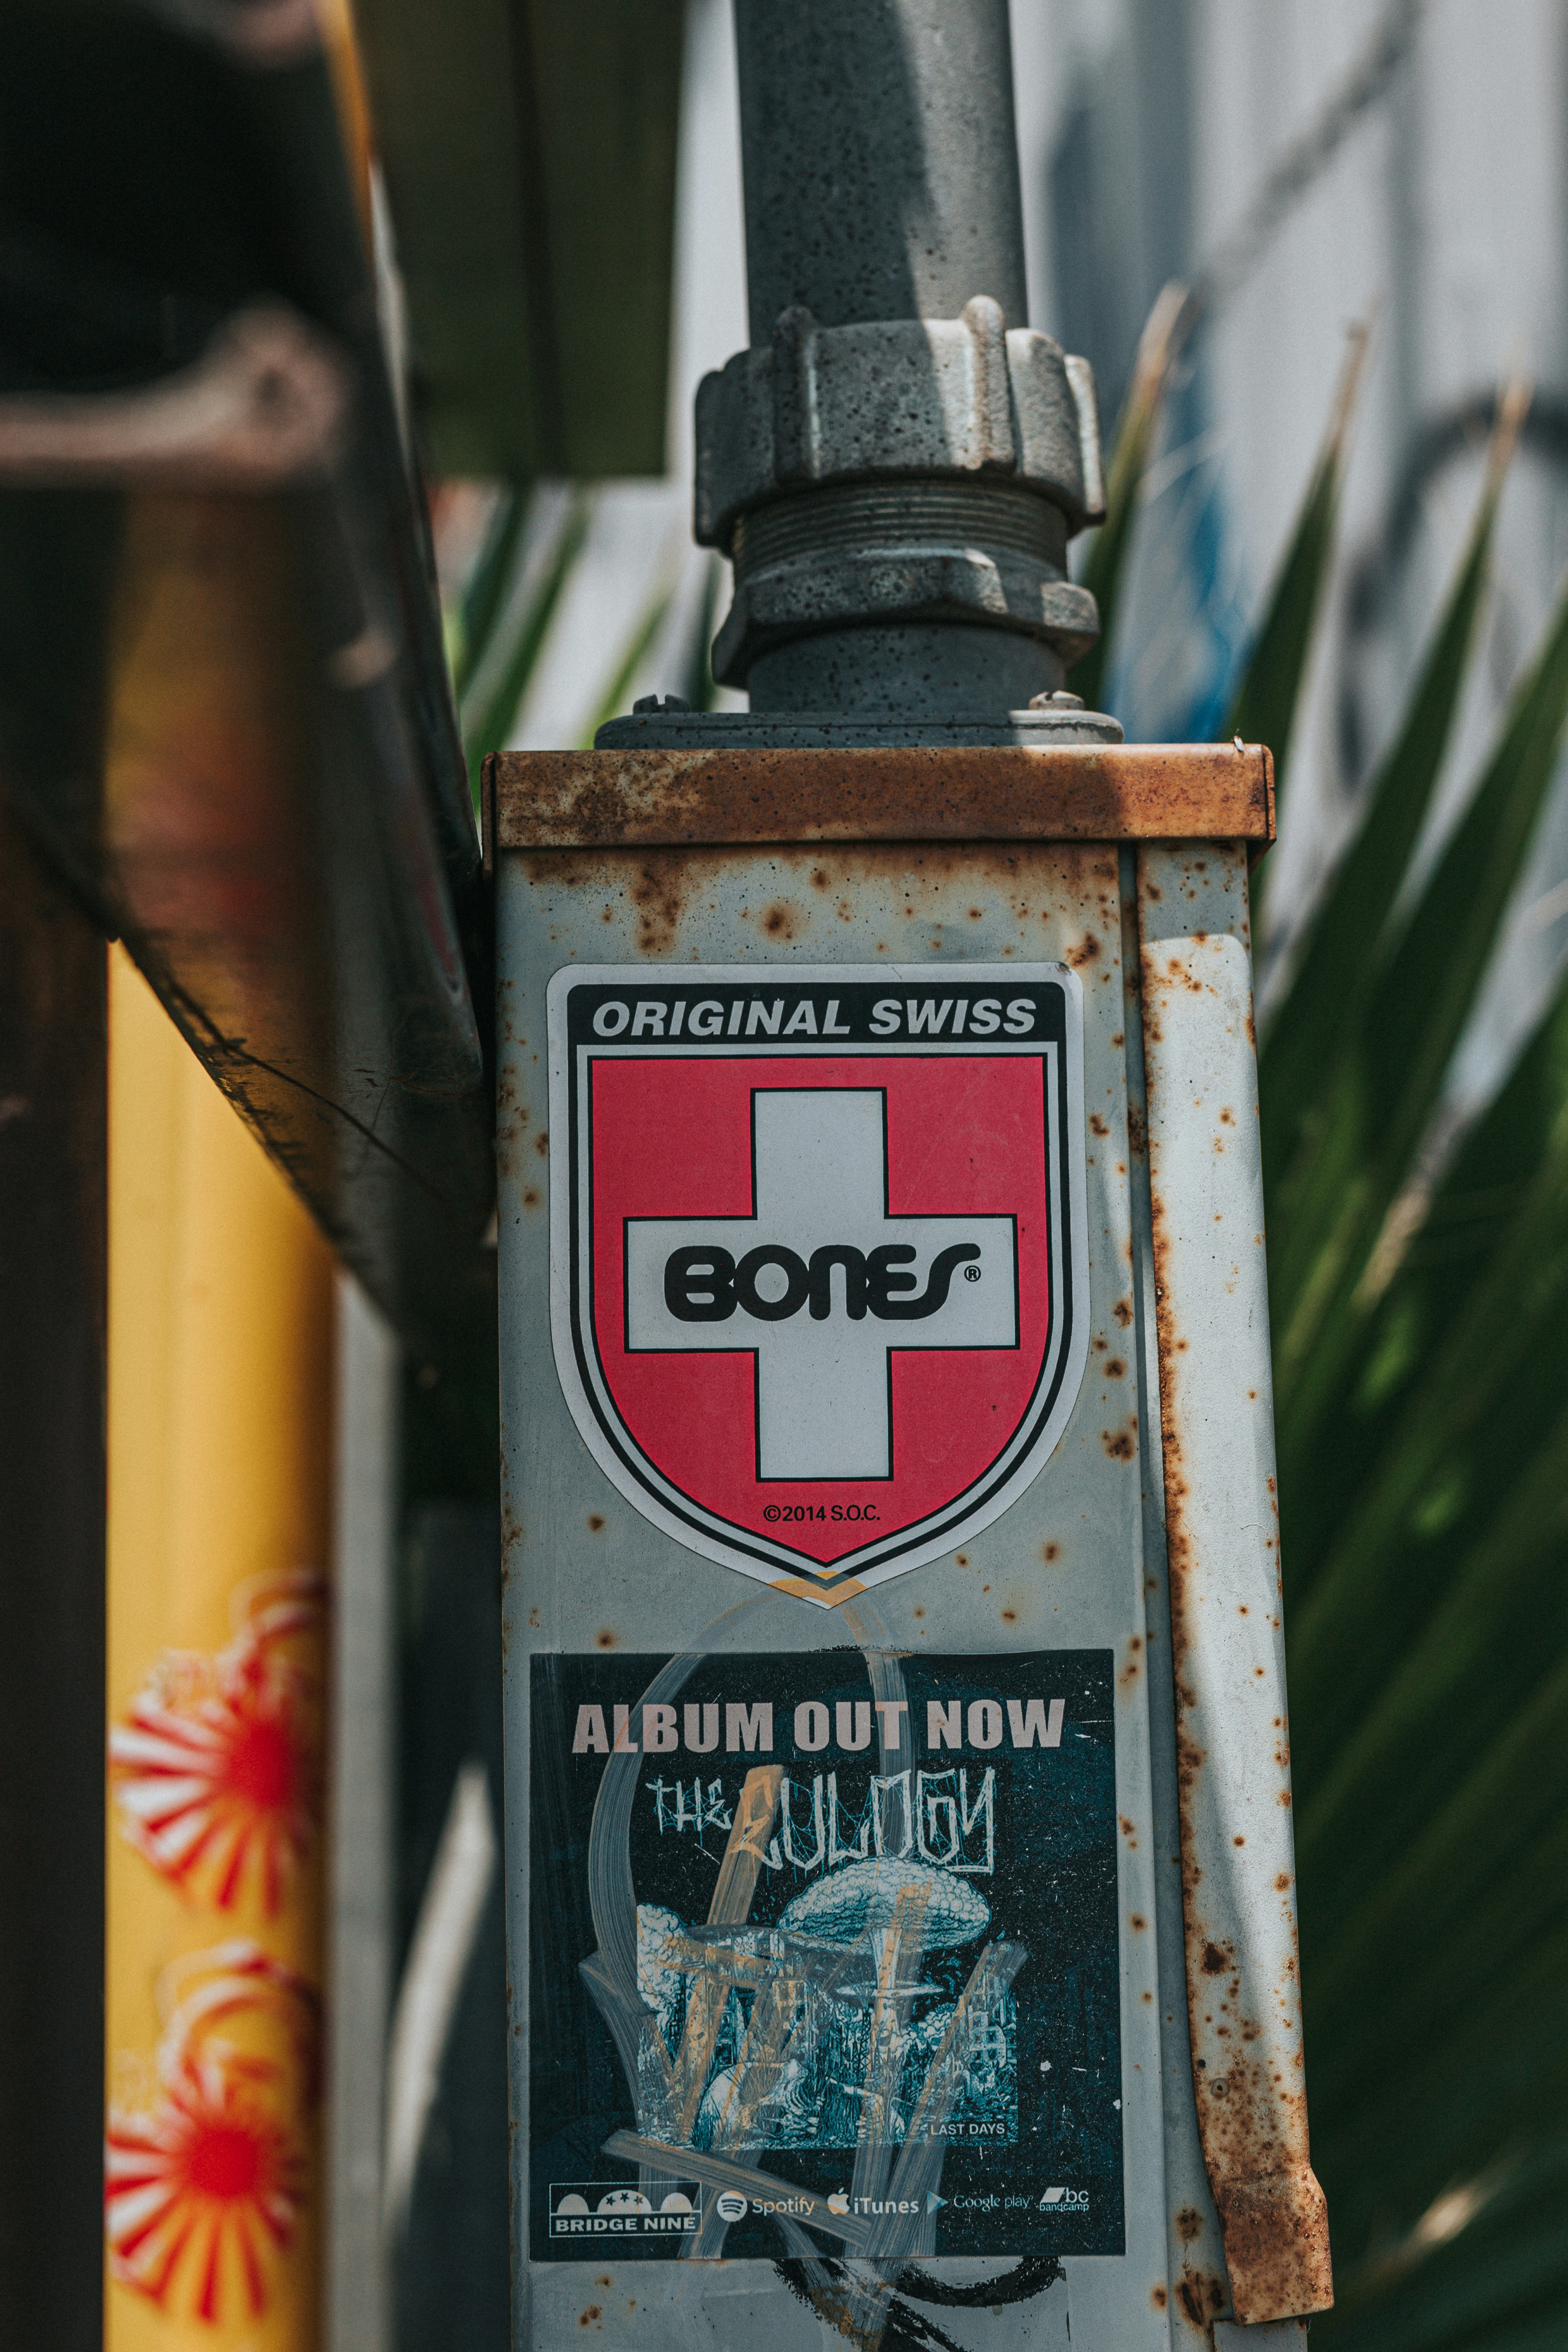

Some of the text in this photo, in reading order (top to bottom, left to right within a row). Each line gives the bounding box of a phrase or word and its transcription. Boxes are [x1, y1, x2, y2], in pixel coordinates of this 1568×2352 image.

[593, 998, 1036, 1037] ORIGINAL SWISS
[830, 1504, 880, 1522] S.O.C.
[572, 1698, 1066, 1753] ALBUM OUT NOW
[931, 2123, 1005, 2135] LAST DAYS
[953, 2194, 1030, 2212] Google play
[1065, 2187, 1089, 2203] bc
[752, 2196, 815, 2216] Spotify
[854, 2197, 919, 2215] iTunes
[1039, 2202, 1089, 2212] bandcamp
[555, 2217, 695, 2232] BRIDGE NINE
